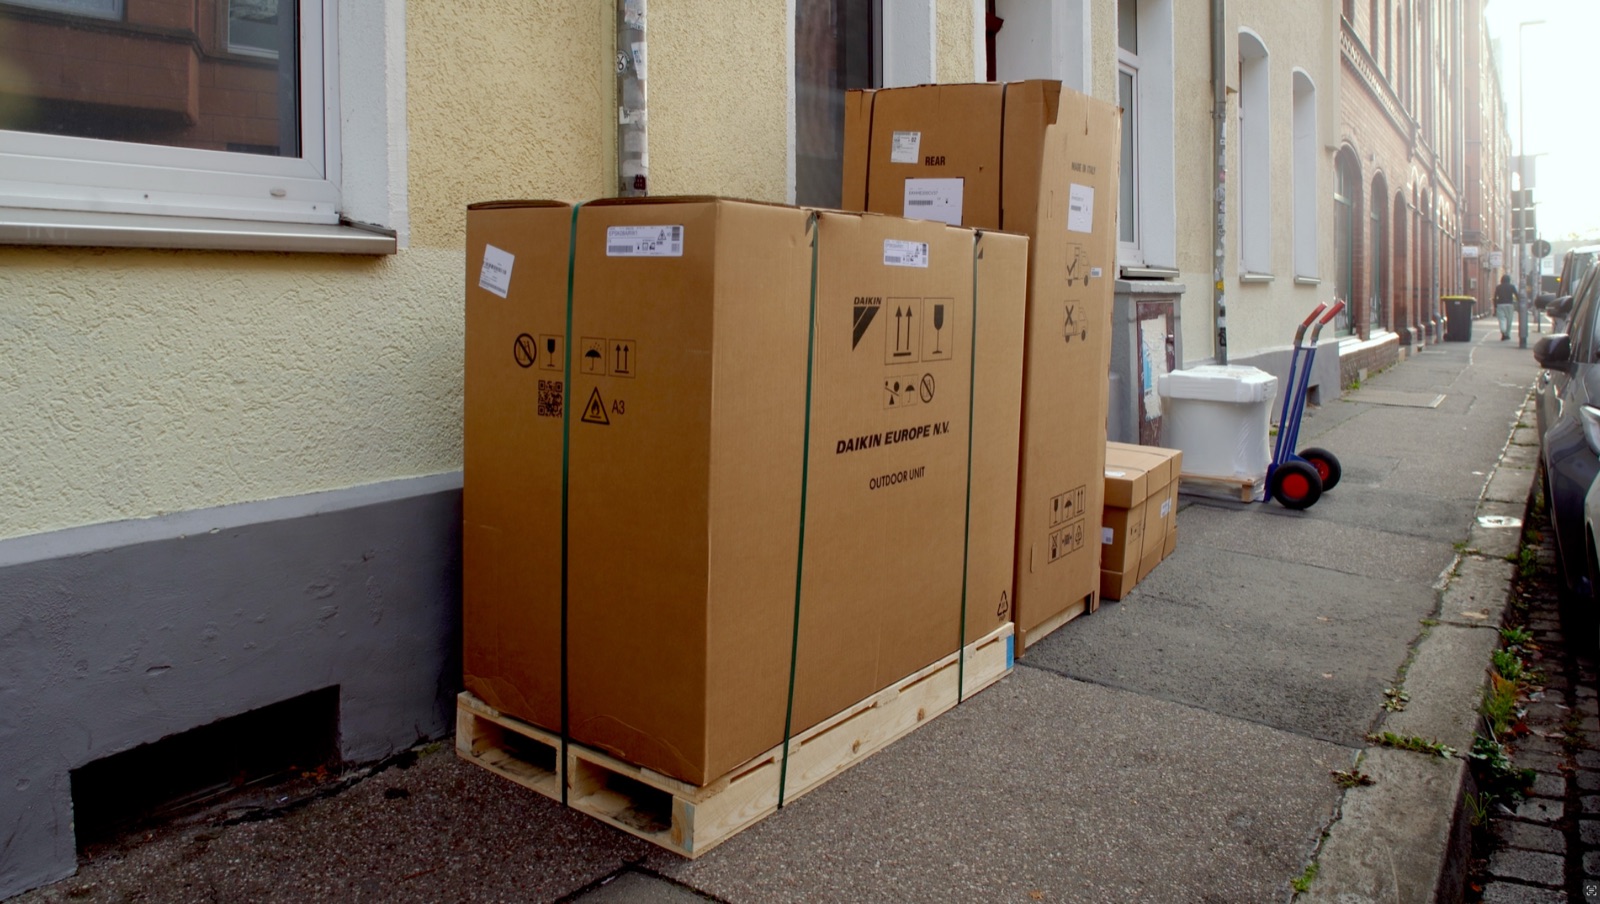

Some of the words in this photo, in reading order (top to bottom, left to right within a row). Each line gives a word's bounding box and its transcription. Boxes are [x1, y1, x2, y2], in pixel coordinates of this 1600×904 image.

[925, 156, 946, 166] REAR
[853, 297, 882, 305] DAIKIN
[611, 399, 625, 415] A3
[836, 434, 882, 454] DAIKIN
[884, 424, 931, 445] EUROPE
[932, 421, 950, 436] N.V.
[869, 471, 908, 490] OUTDOOR
[909, 466, 925, 481] UNIT
